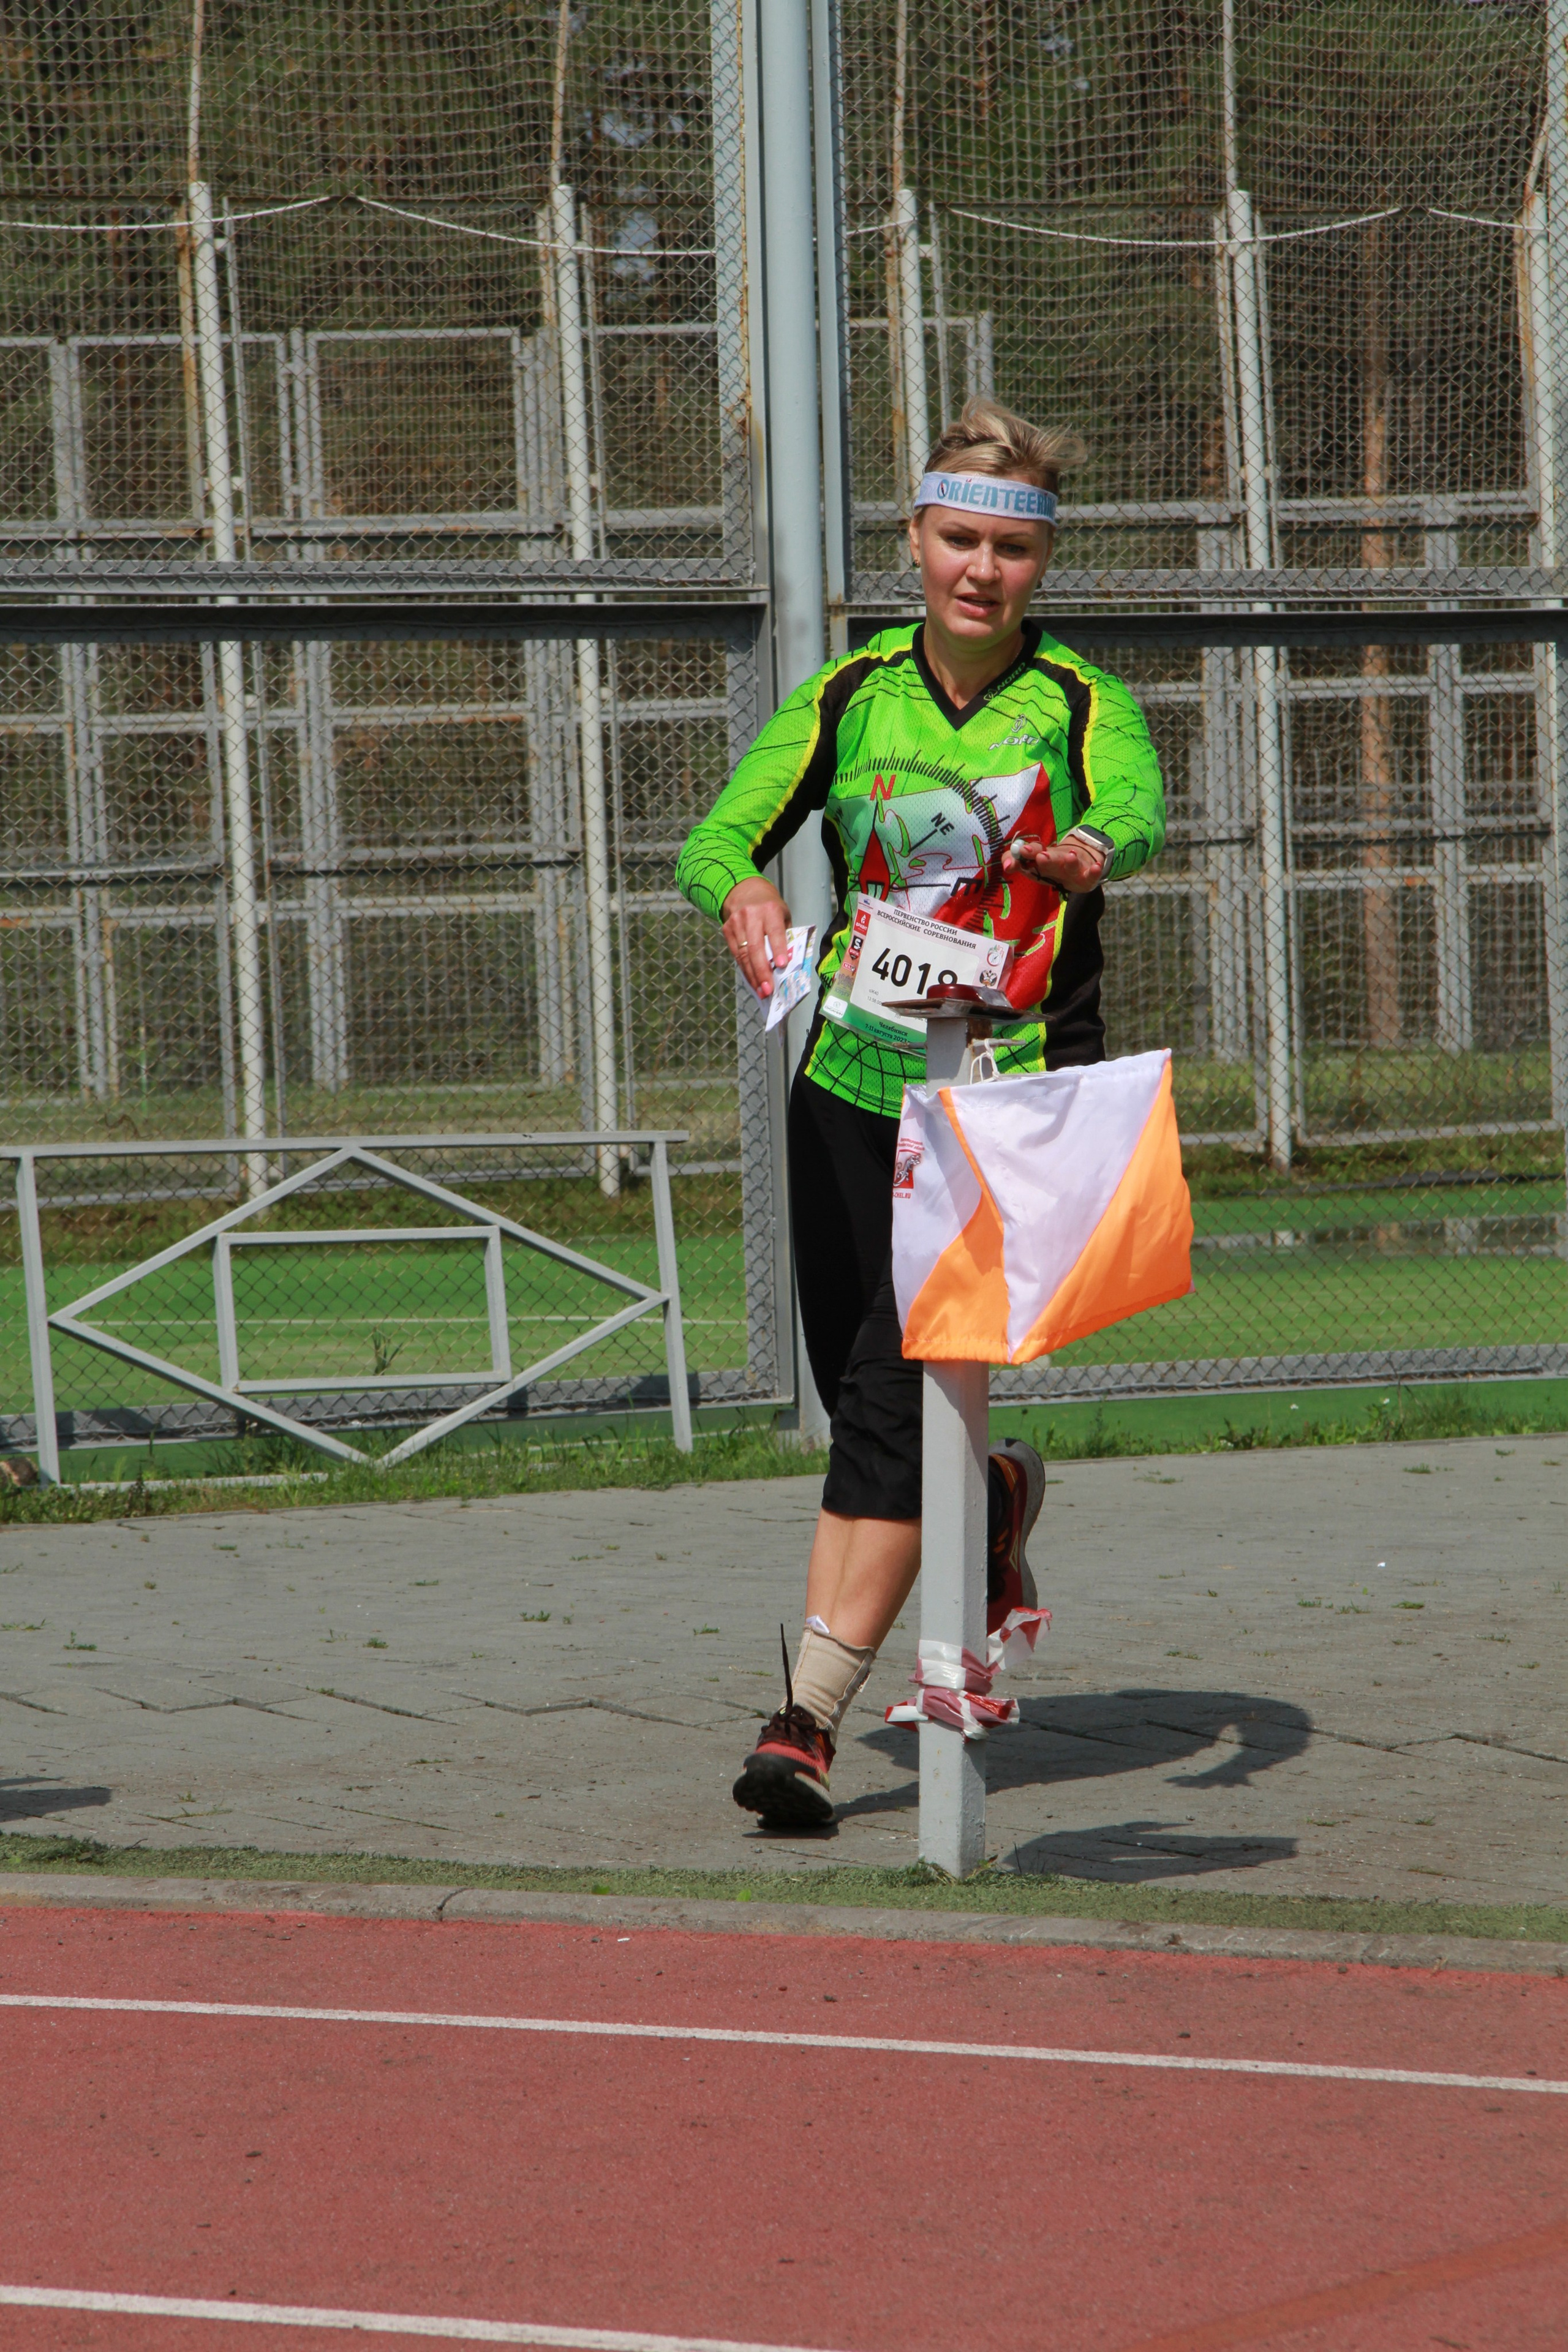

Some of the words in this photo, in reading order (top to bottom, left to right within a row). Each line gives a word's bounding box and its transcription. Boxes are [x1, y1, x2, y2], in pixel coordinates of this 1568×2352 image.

[870, 774, 896, 801] N
[930, 812, 955, 835] NE
[876, 910, 921, 932] ВСЕРОССИЙСКИЕ
[923, 929, 976, 949] СОРЕВНОВАНИЯ
[893, 909, 930, 927] ПЕРВЕНСТВО
[930, 922, 958, 936] РОССИИ
[874, 1028, 893, 1039] августа
[879, 1022, 908, 1036] Челябинск
